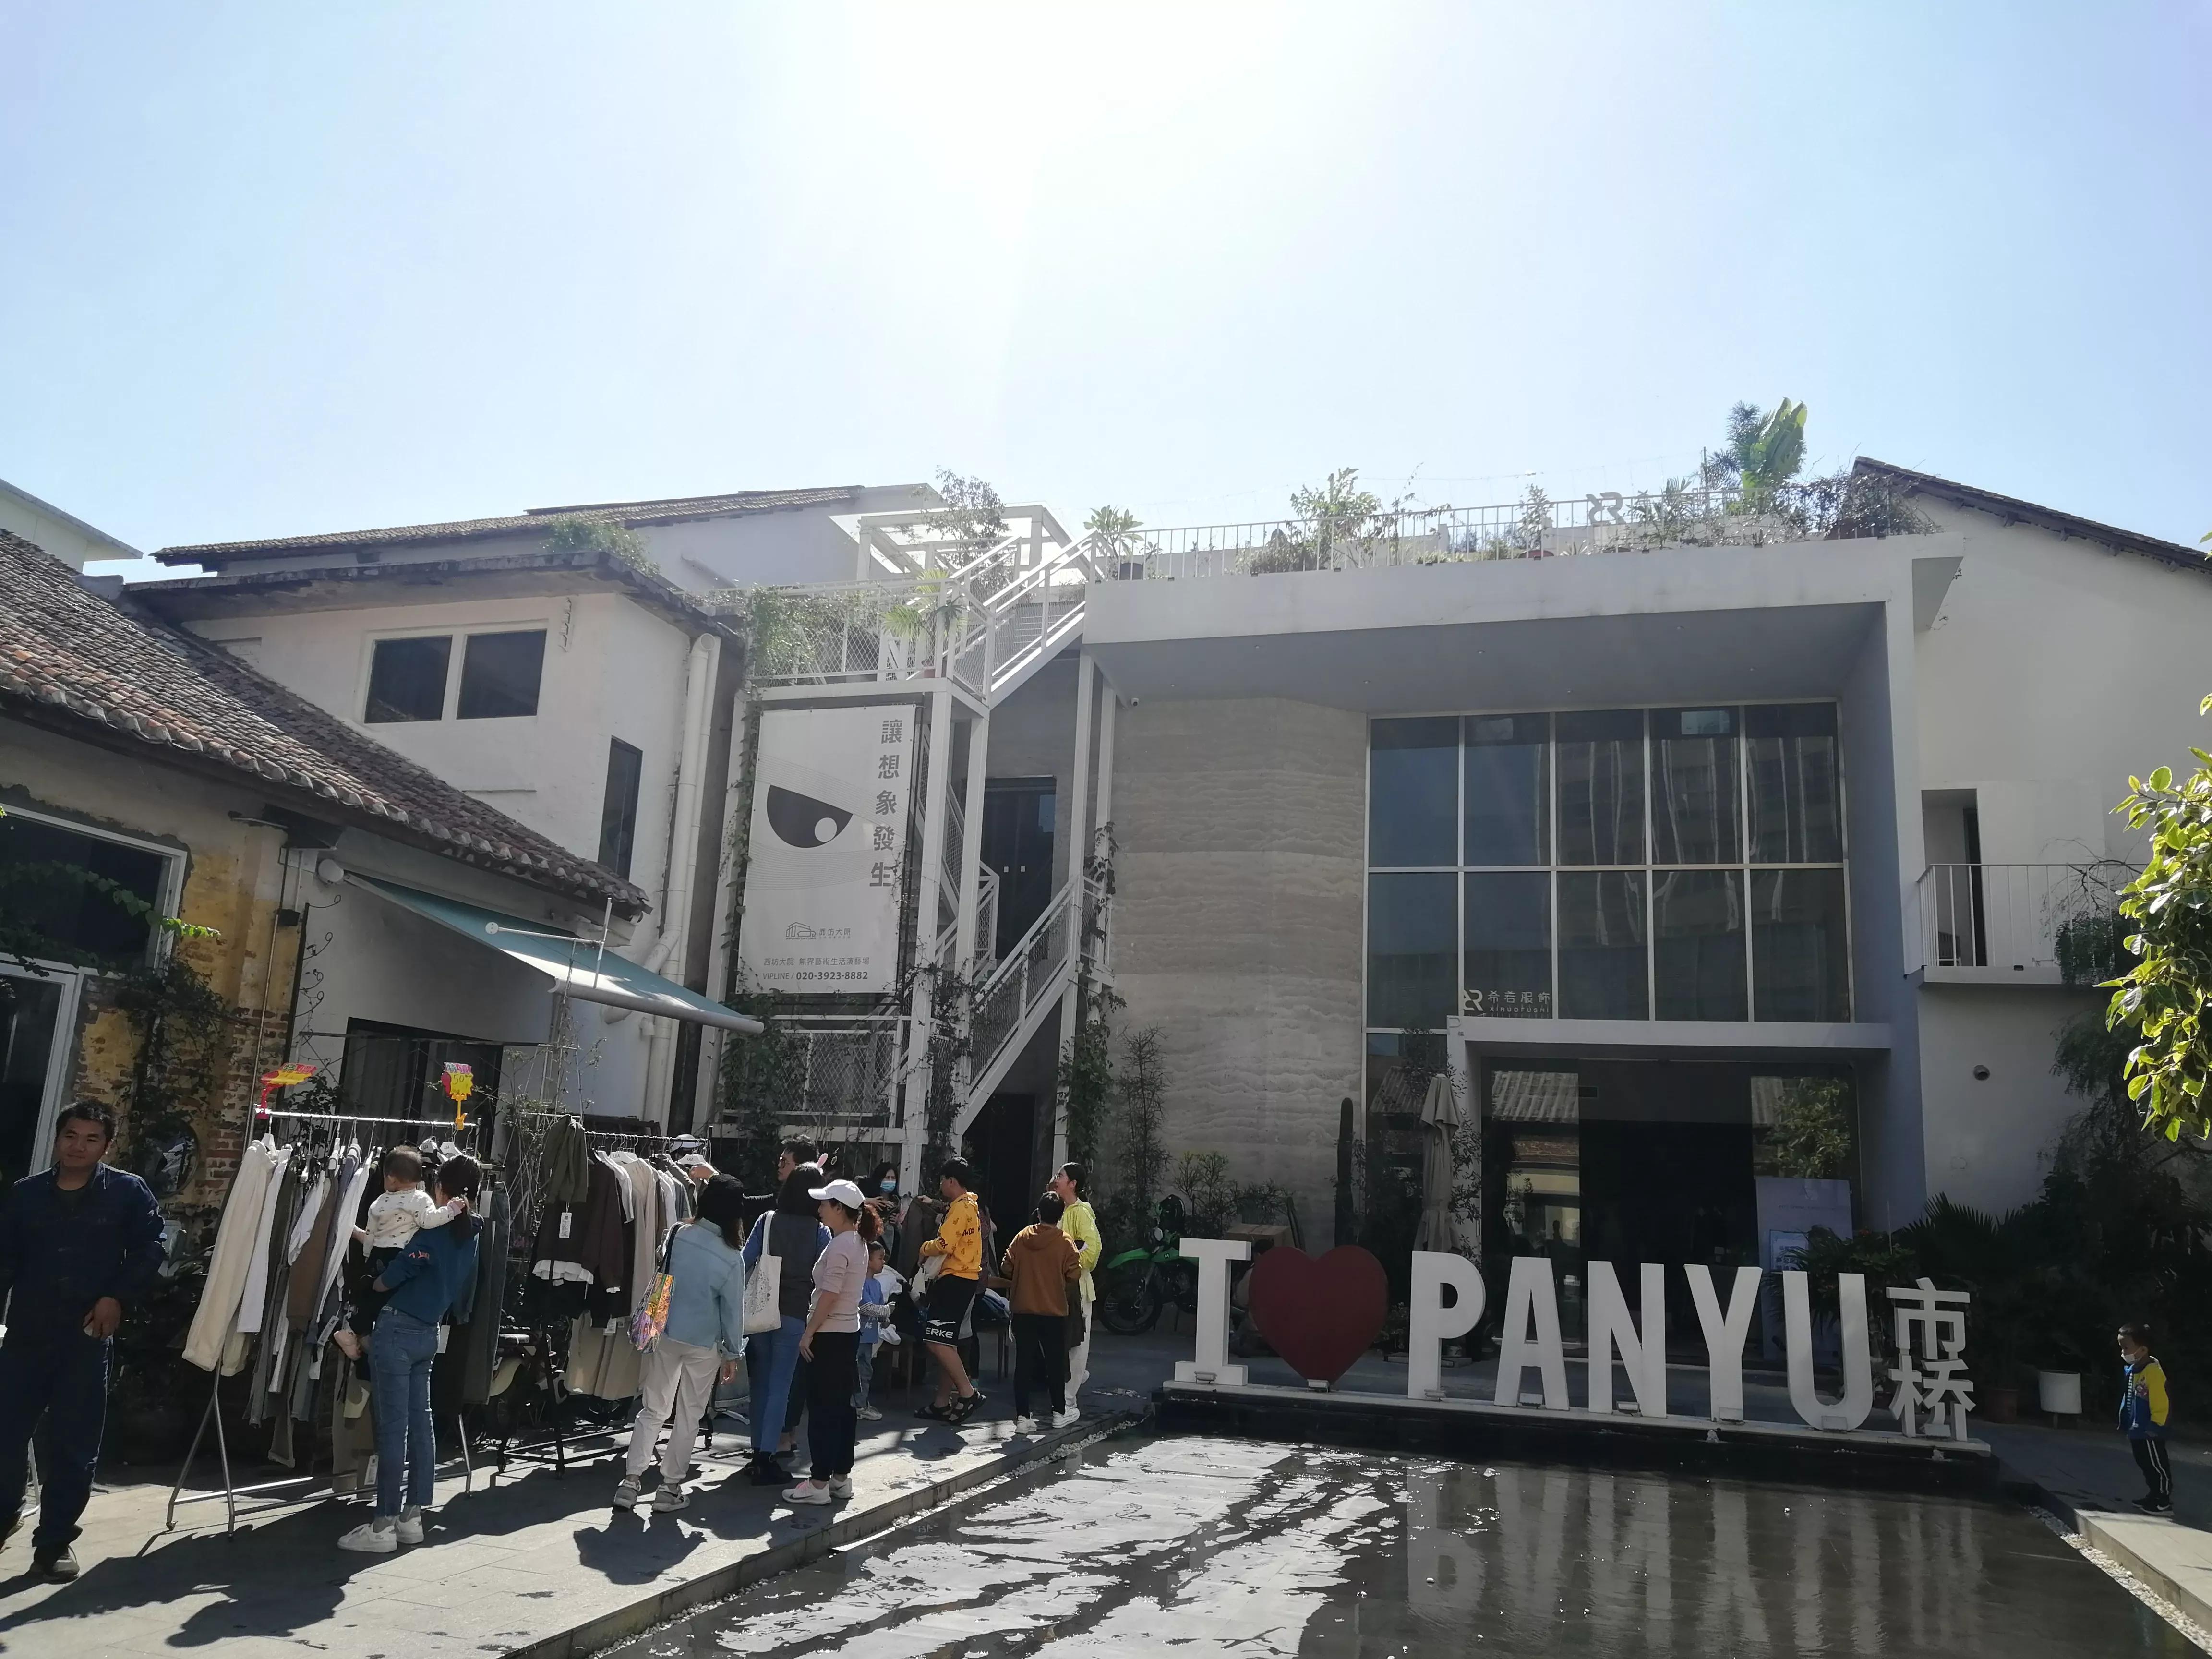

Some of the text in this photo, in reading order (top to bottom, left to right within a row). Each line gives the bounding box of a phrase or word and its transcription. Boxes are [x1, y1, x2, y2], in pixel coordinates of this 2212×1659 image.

[869, 719, 902, 887] 讓想象發生
[764, 958, 794, 966] 西坊大院
[796, 972, 868, 980] 020-3923-8882
[925, 1327, 953, 1338] ERKE
[1174, 1238, 1872, 1431] I PANYU
[1886, 1277, 1976, 1441] 市桥
